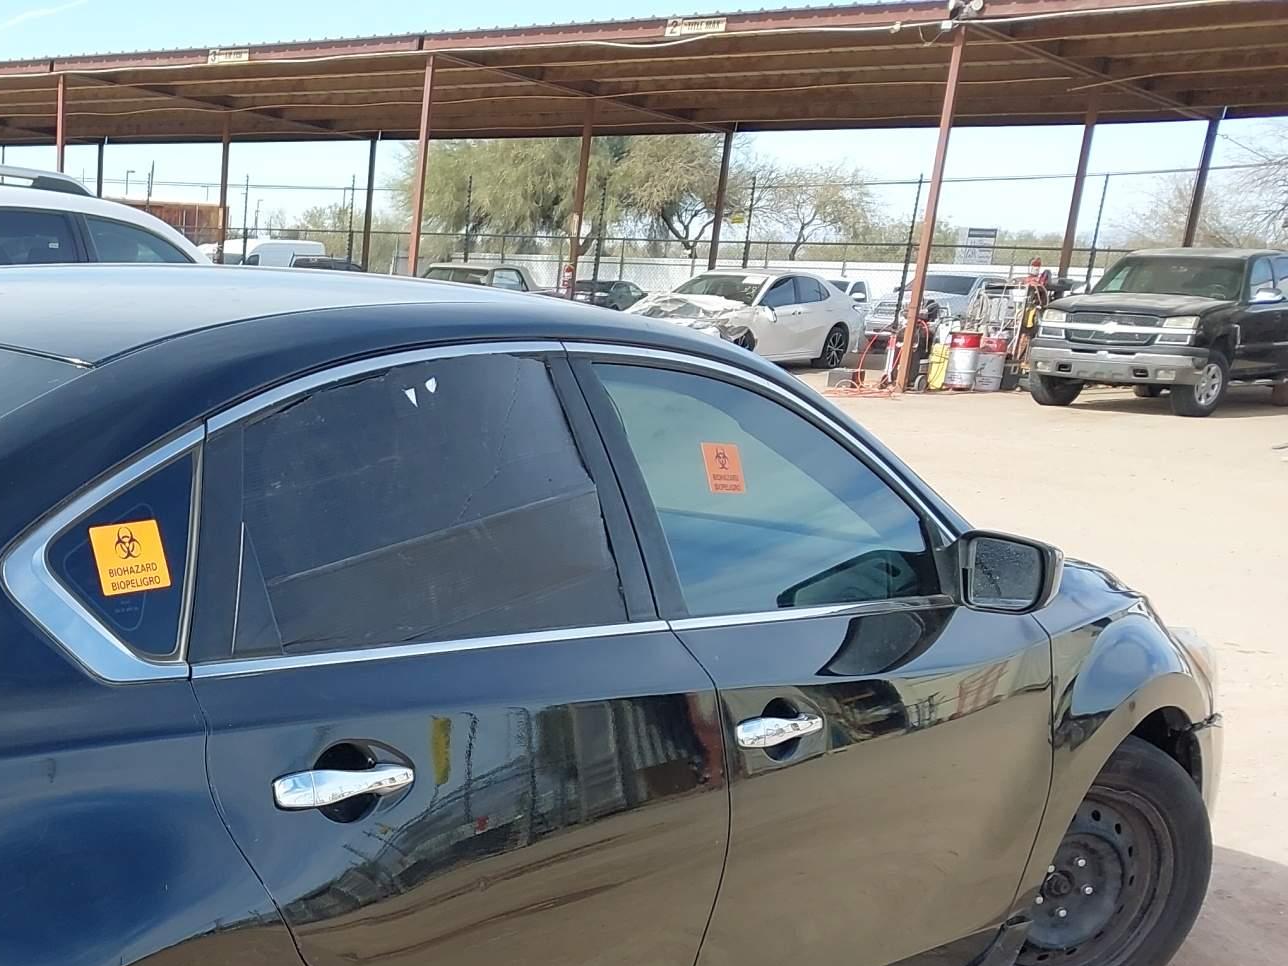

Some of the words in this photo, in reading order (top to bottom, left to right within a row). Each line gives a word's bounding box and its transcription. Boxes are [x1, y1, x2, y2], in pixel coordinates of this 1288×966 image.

[670, 20, 679, 34] 2
[108, 563, 158, 577] BIOHAZARD
[111, 575, 161, 591] BIOPELIGRO
